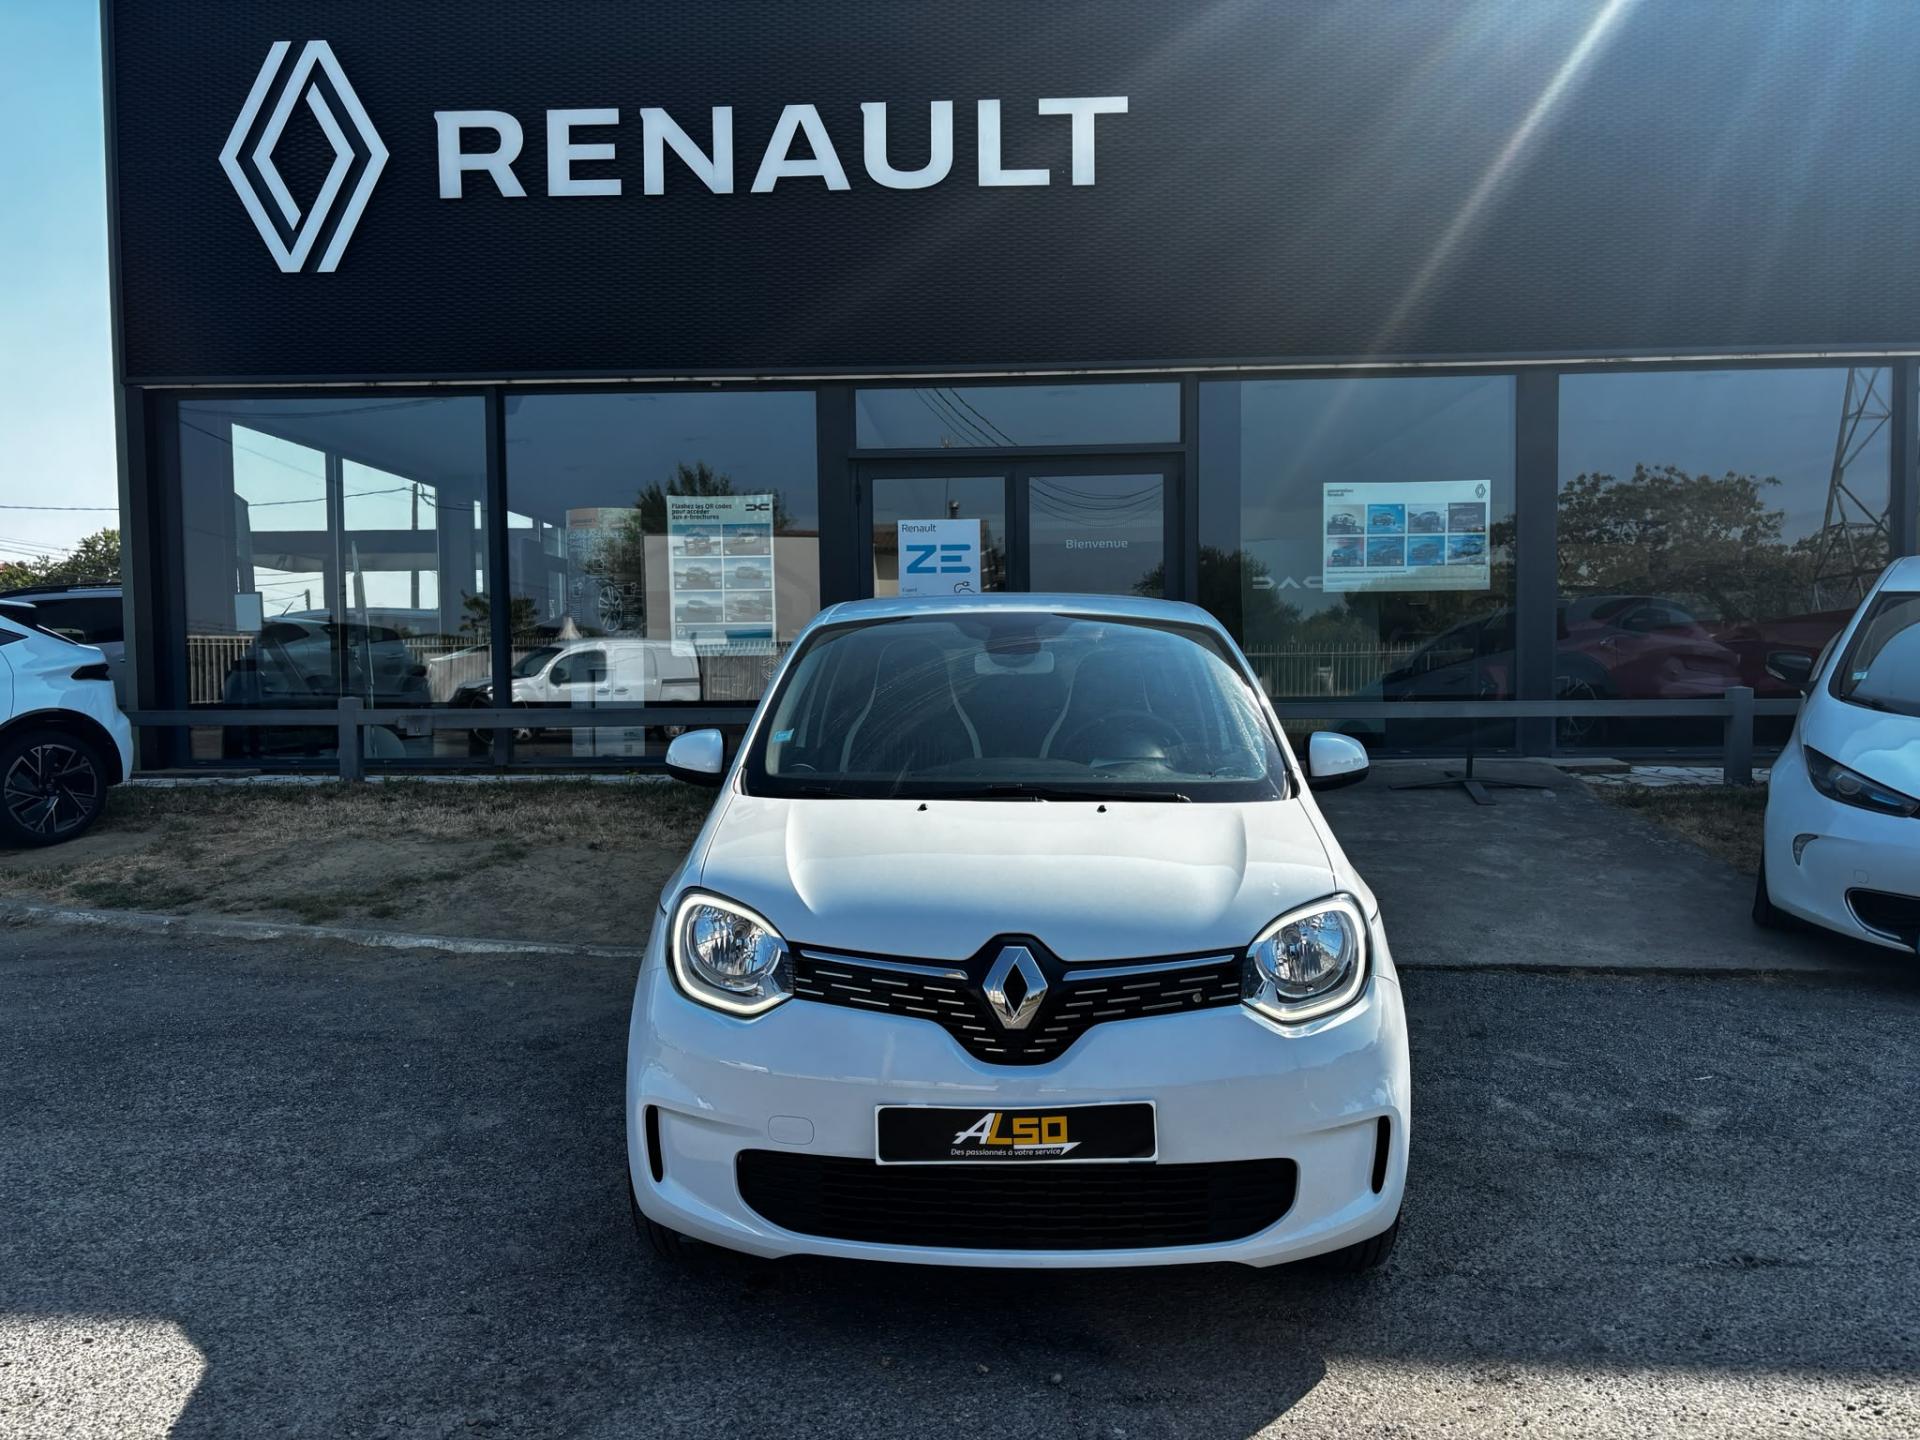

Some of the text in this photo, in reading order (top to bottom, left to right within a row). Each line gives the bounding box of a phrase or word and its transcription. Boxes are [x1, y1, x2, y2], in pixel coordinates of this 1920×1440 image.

[434, 96, 1128, 199] RENAULT
[901, 523, 937, 533] Renault
[1065, 538, 1129, 550] Bienvenue
[906, 544, 972, 574] ZE
[1252, 576, 1324, 590] DAC
[952, 1112, 1069, 1145] ALSO
[950, 1148, 965, 1156] Des
[965, 1148, 1007, 1157] passionnés
[1034, 1147, 1062, 1155] service
